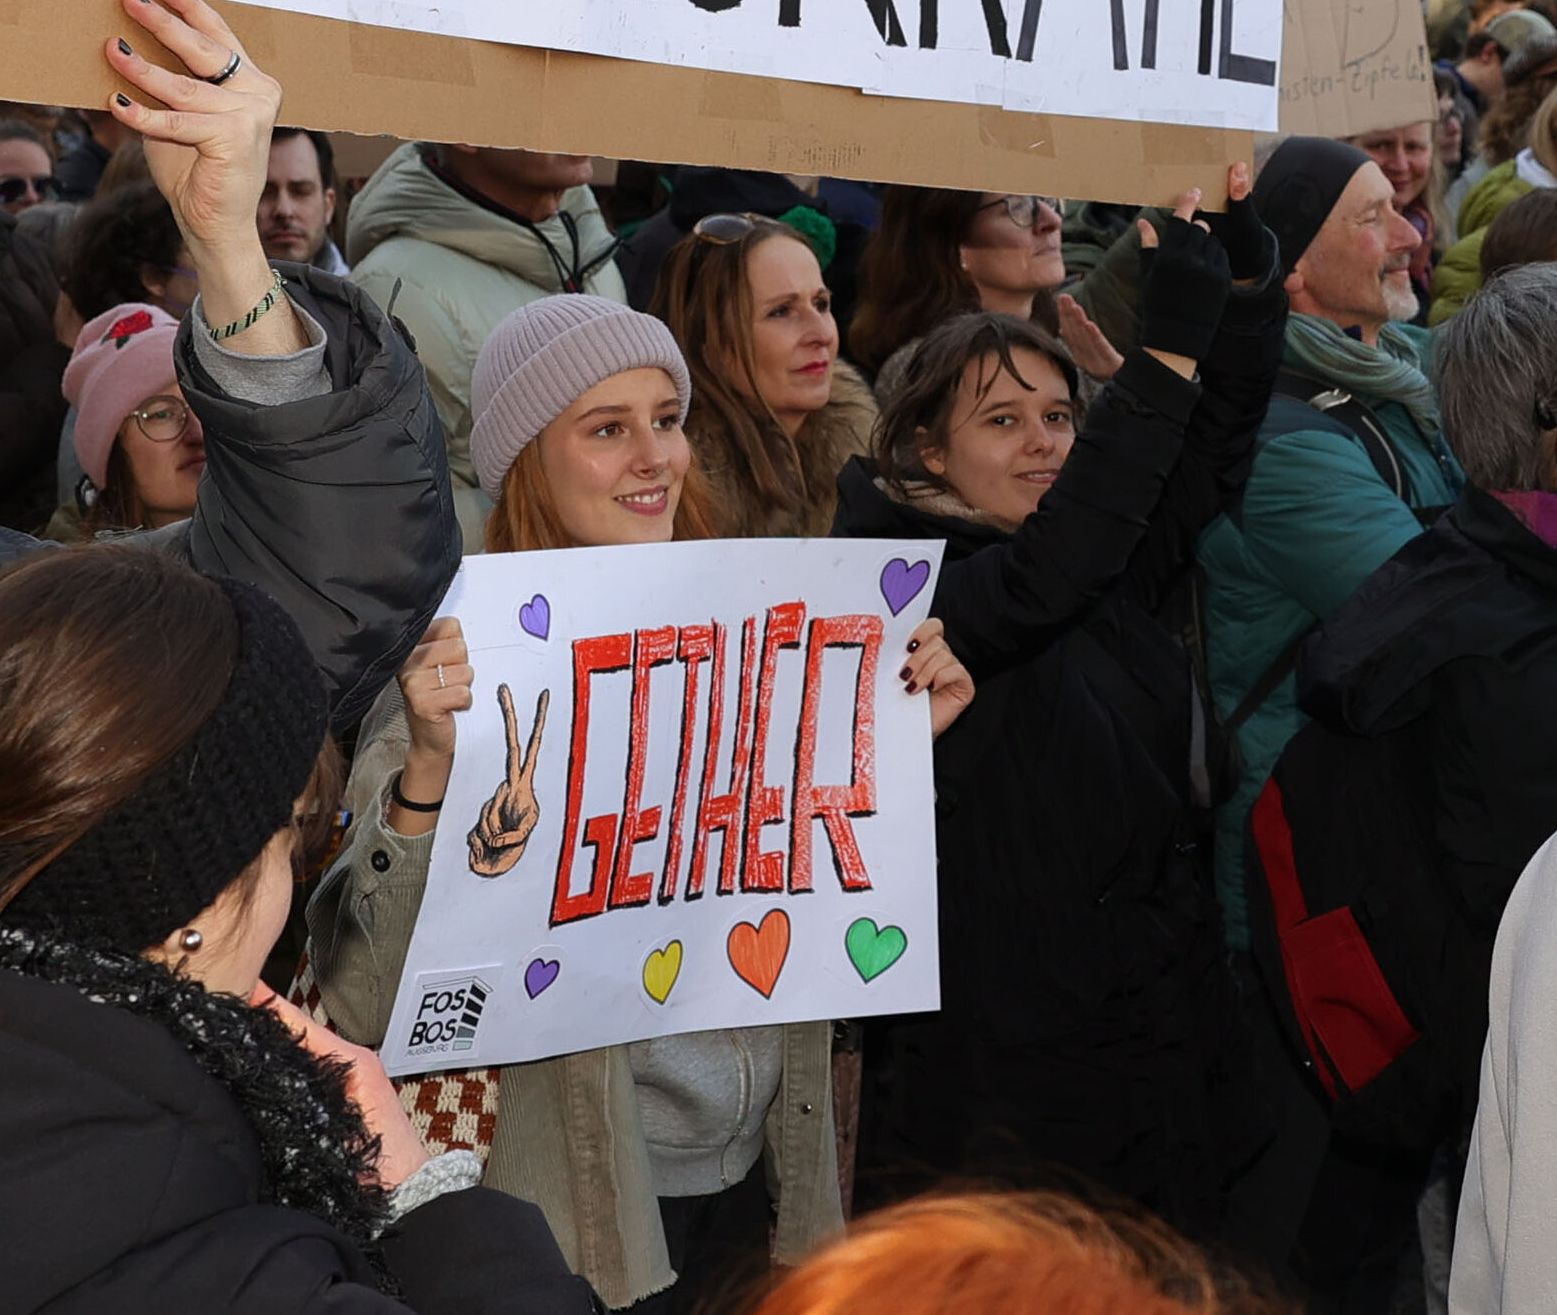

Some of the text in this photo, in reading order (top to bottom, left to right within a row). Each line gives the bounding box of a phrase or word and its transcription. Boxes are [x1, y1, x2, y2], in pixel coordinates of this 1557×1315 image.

[549, 598, 885, 930] GETHER
[417, 989, 466, 1021] FOS
[408, 1019, 458, 1047] BOS
